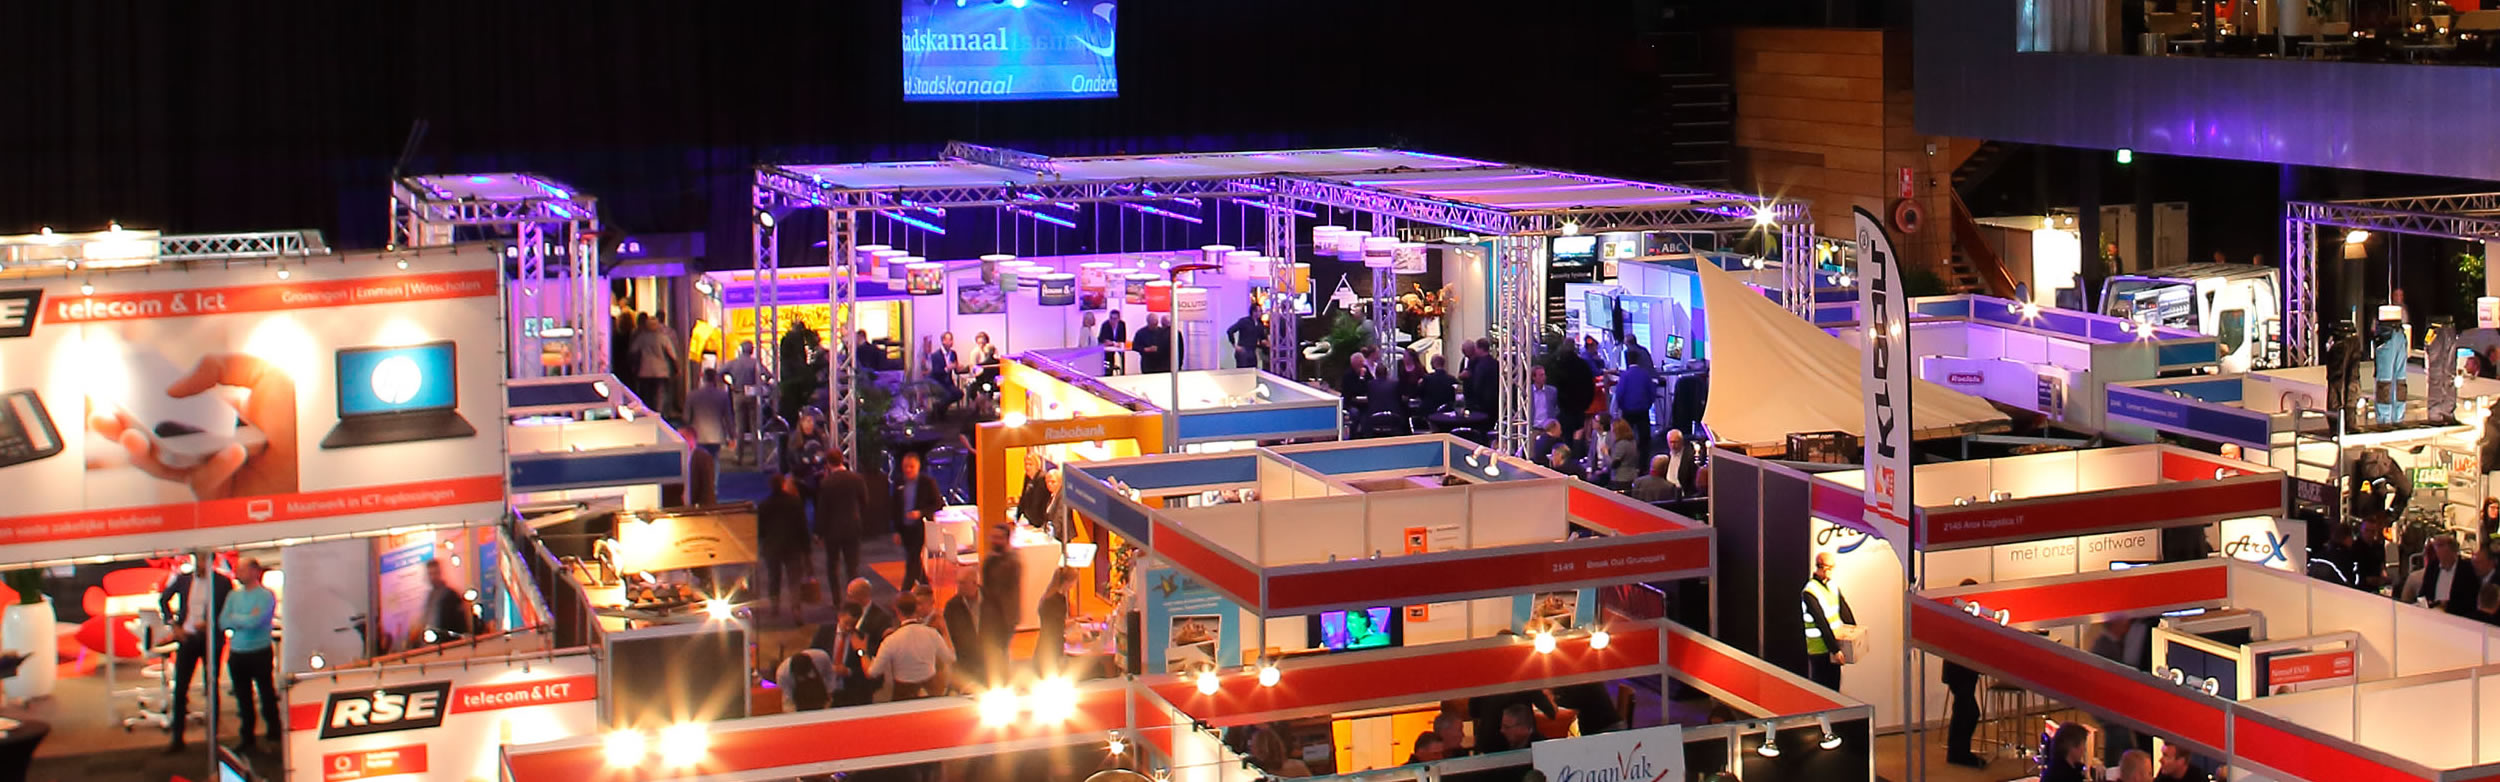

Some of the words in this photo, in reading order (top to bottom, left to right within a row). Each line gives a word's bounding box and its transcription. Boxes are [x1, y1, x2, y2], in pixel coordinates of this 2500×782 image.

[1661, 242, 1684, 253] ABC
[281, 289, 348, 304] Groningen
[356, 286, 403, 298] Emmen
[411, 281, 480, 294] Winschoten
[58, 298, 162, 319] telecom
[170, 293, 187, 313] &
[1045, 424, 1105, 439] Rabobank
[2010, 547, 2038, 561] met
[2042, 543, 2075, 558] onze
[2088, 535, 2146, 553] software
[331, 690, 440, 728] RSE
[464, 688, 527, 707] telecom
[530, 687, 543, 700] &
[545, 683, 571, 698] ICT
